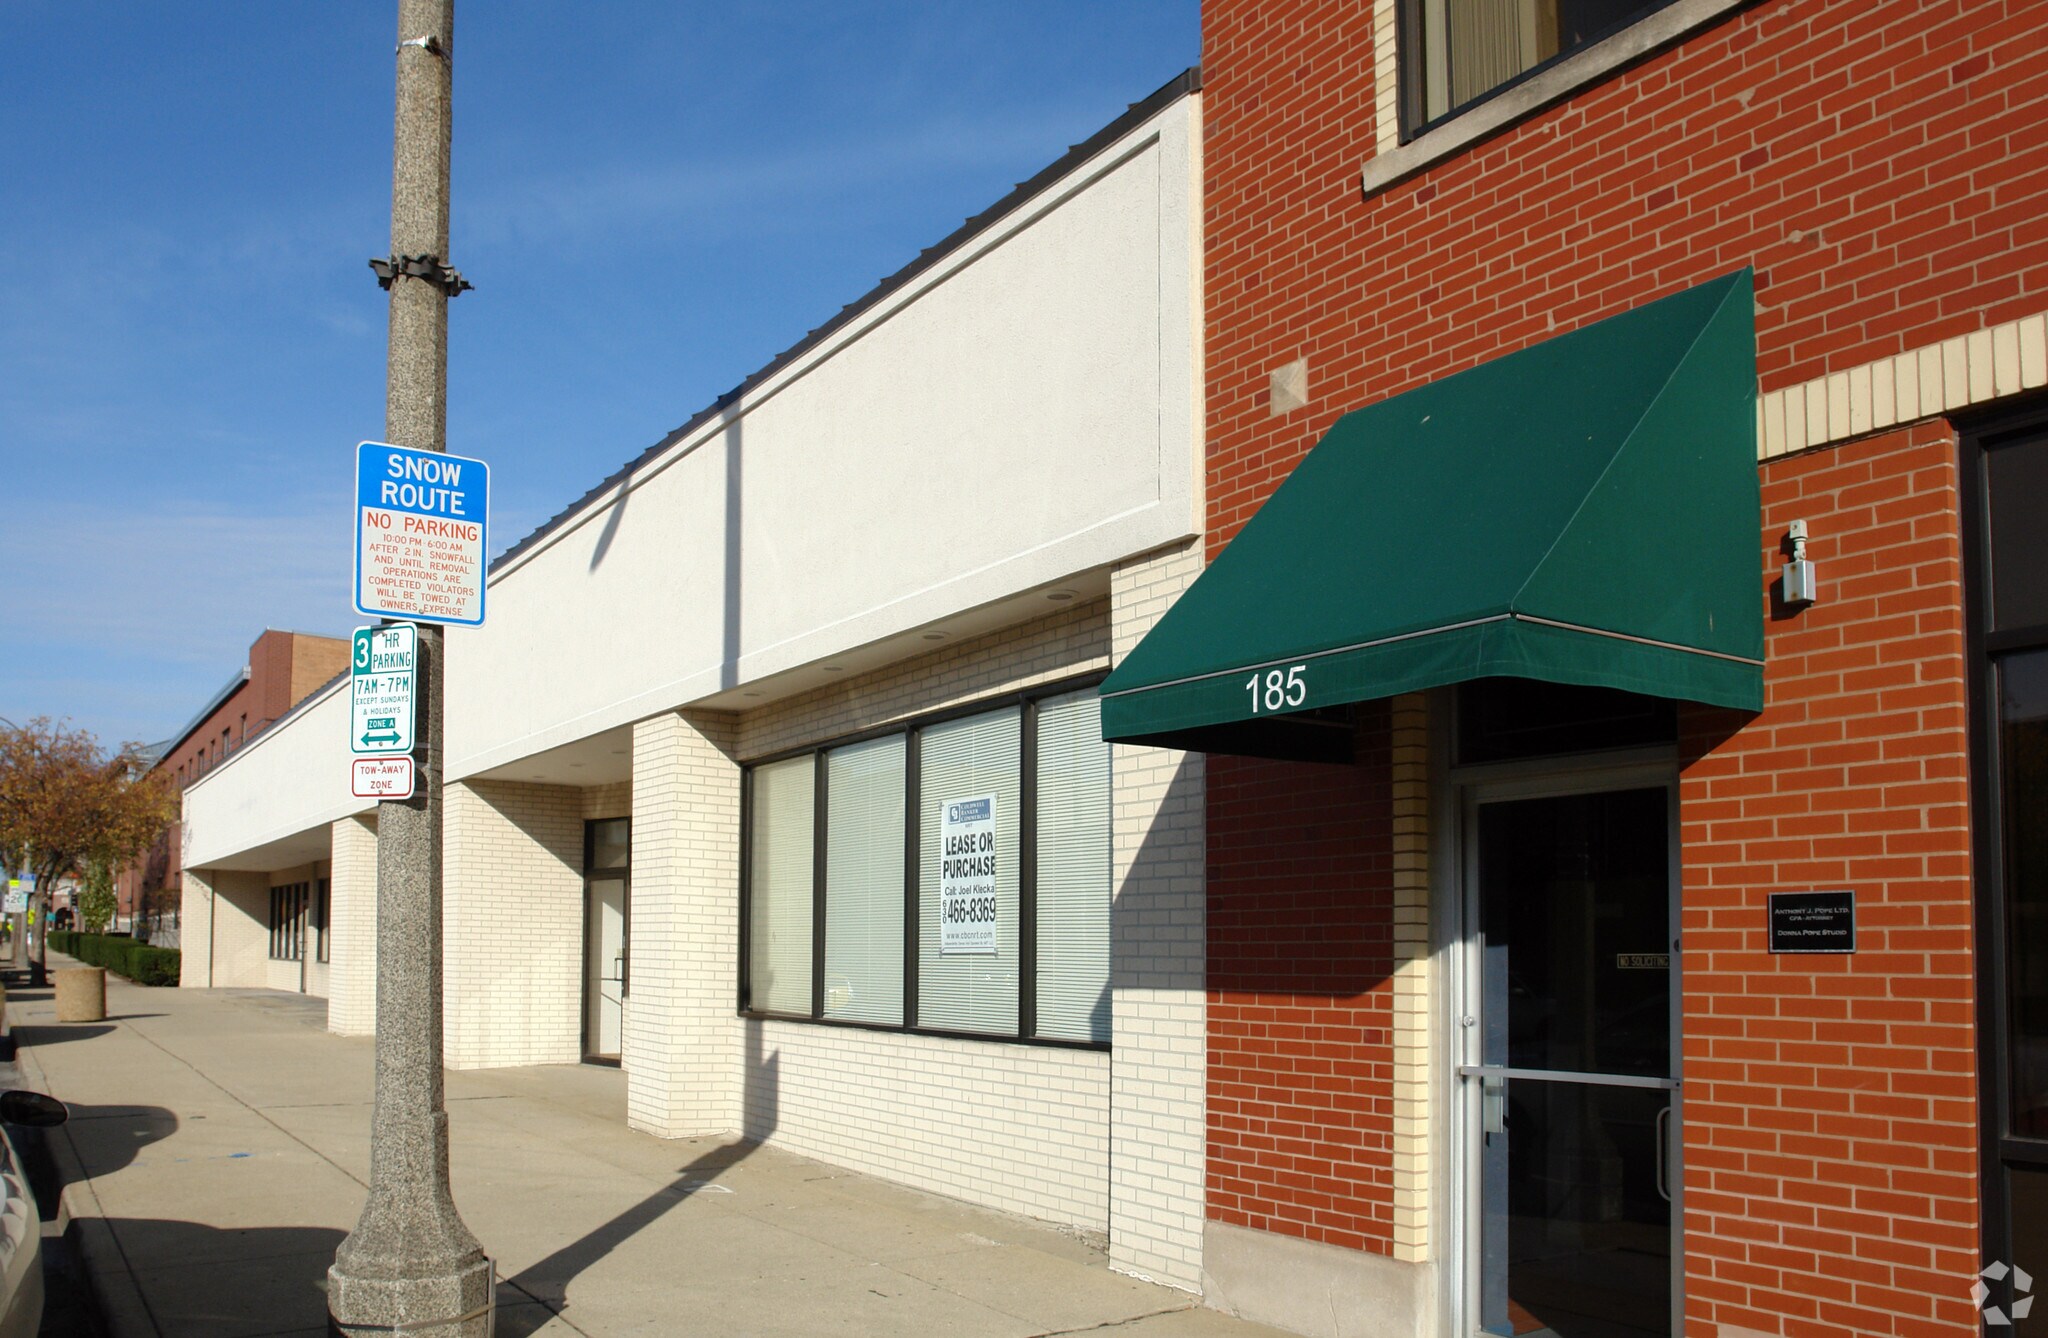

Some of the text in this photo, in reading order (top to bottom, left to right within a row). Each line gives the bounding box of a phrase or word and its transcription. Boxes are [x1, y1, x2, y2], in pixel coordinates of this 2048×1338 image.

[387, 453, 461, 487] SNOW
[381, 480, 465, 515] ROUTE
[367, 511, 478, 542] NO PARKING
[383, 533, 407, 544] 10:00
[409, 538, 422, 547] PM
[427, 540, 447, 550] 6:00
[449, 542, 463, 552] AM
[369, 543, 475, 565] AFTER 2 IN. SNOWFALL
[374, 555, 470, 575] AND UNTIL REMOVAL
[382, 566, 461, 584] OPERATIONS ARE
[368, 575, 475, 597] COMPLETED VIOLATORS
[376, 587, 466, 606] WILL BE TOWED AT
[380, 599, 463, 617] OWNERS EXPENSE
[355, 632, 400, 668] 3 HR
[373, 651, 412, 669] PARKING
[357, 679, 378, 695] 7AM
[387, 676, 409, 693] 7PM
[1246, 665, 1307, 714] 185
[355, 695, 410, 706] EXCEPT SUNDAYS
[362, 706, 401, 715] & HOLIDAYS
[368, 718, 395, 729] ZONE A
[360, 765, 405, 775] TOW-AWAY
[370, 780, 393, 790] ZONE
[945, 831, 994, 856] LEASE OR
[943, 855, 995, 880] PURCHASE
[958, 884, 972, 895] Joel
[973, 883, 995, 894] Klecka
[947, 897, 996, 924] 466-8369
[1620, 956, 1669, 967] NO SOLICITING
